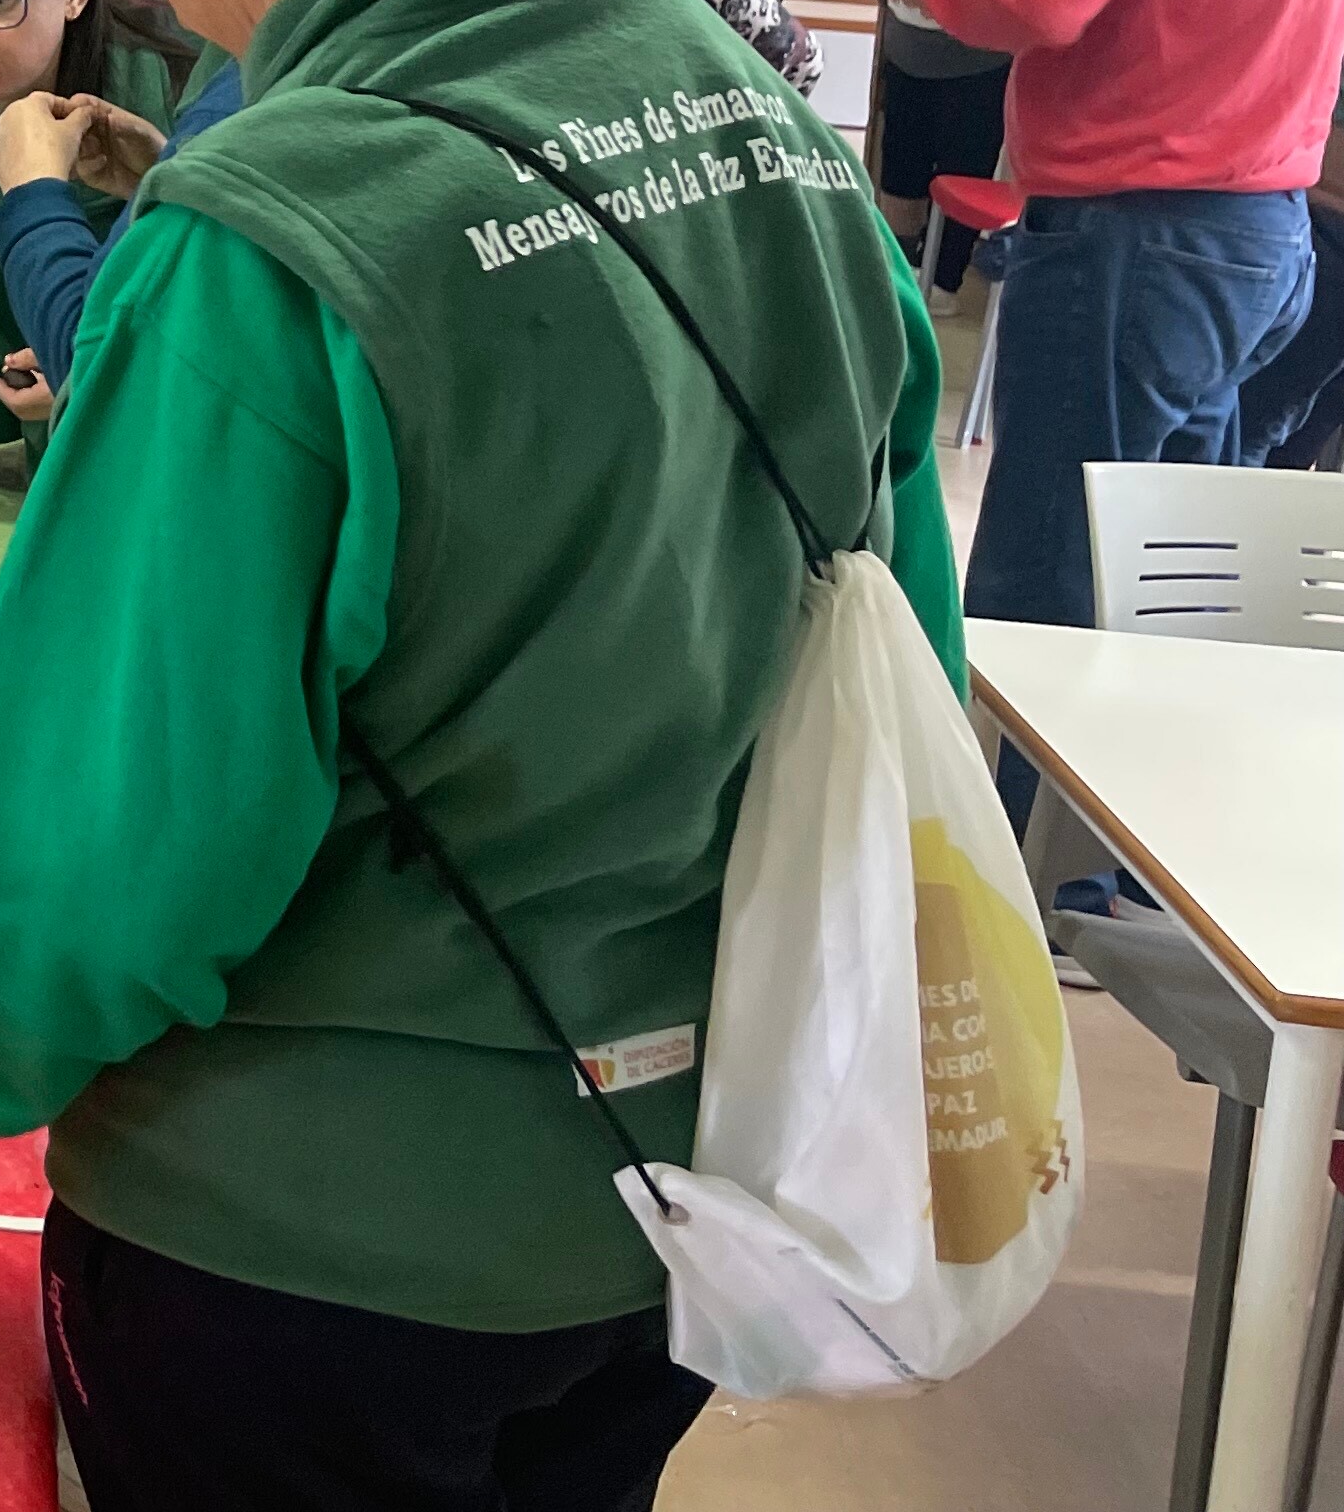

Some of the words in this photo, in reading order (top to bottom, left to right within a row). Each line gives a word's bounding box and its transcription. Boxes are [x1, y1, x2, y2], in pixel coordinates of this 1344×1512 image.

[559, 117, 644, 164] Fines
[642, 97, 677, 143] de
[465, 186, 646, 272] Mensajros
[644, 166, 677, 212] de
[671, 158, 705, 205] la
[698, 151, 746, 197] Paz
